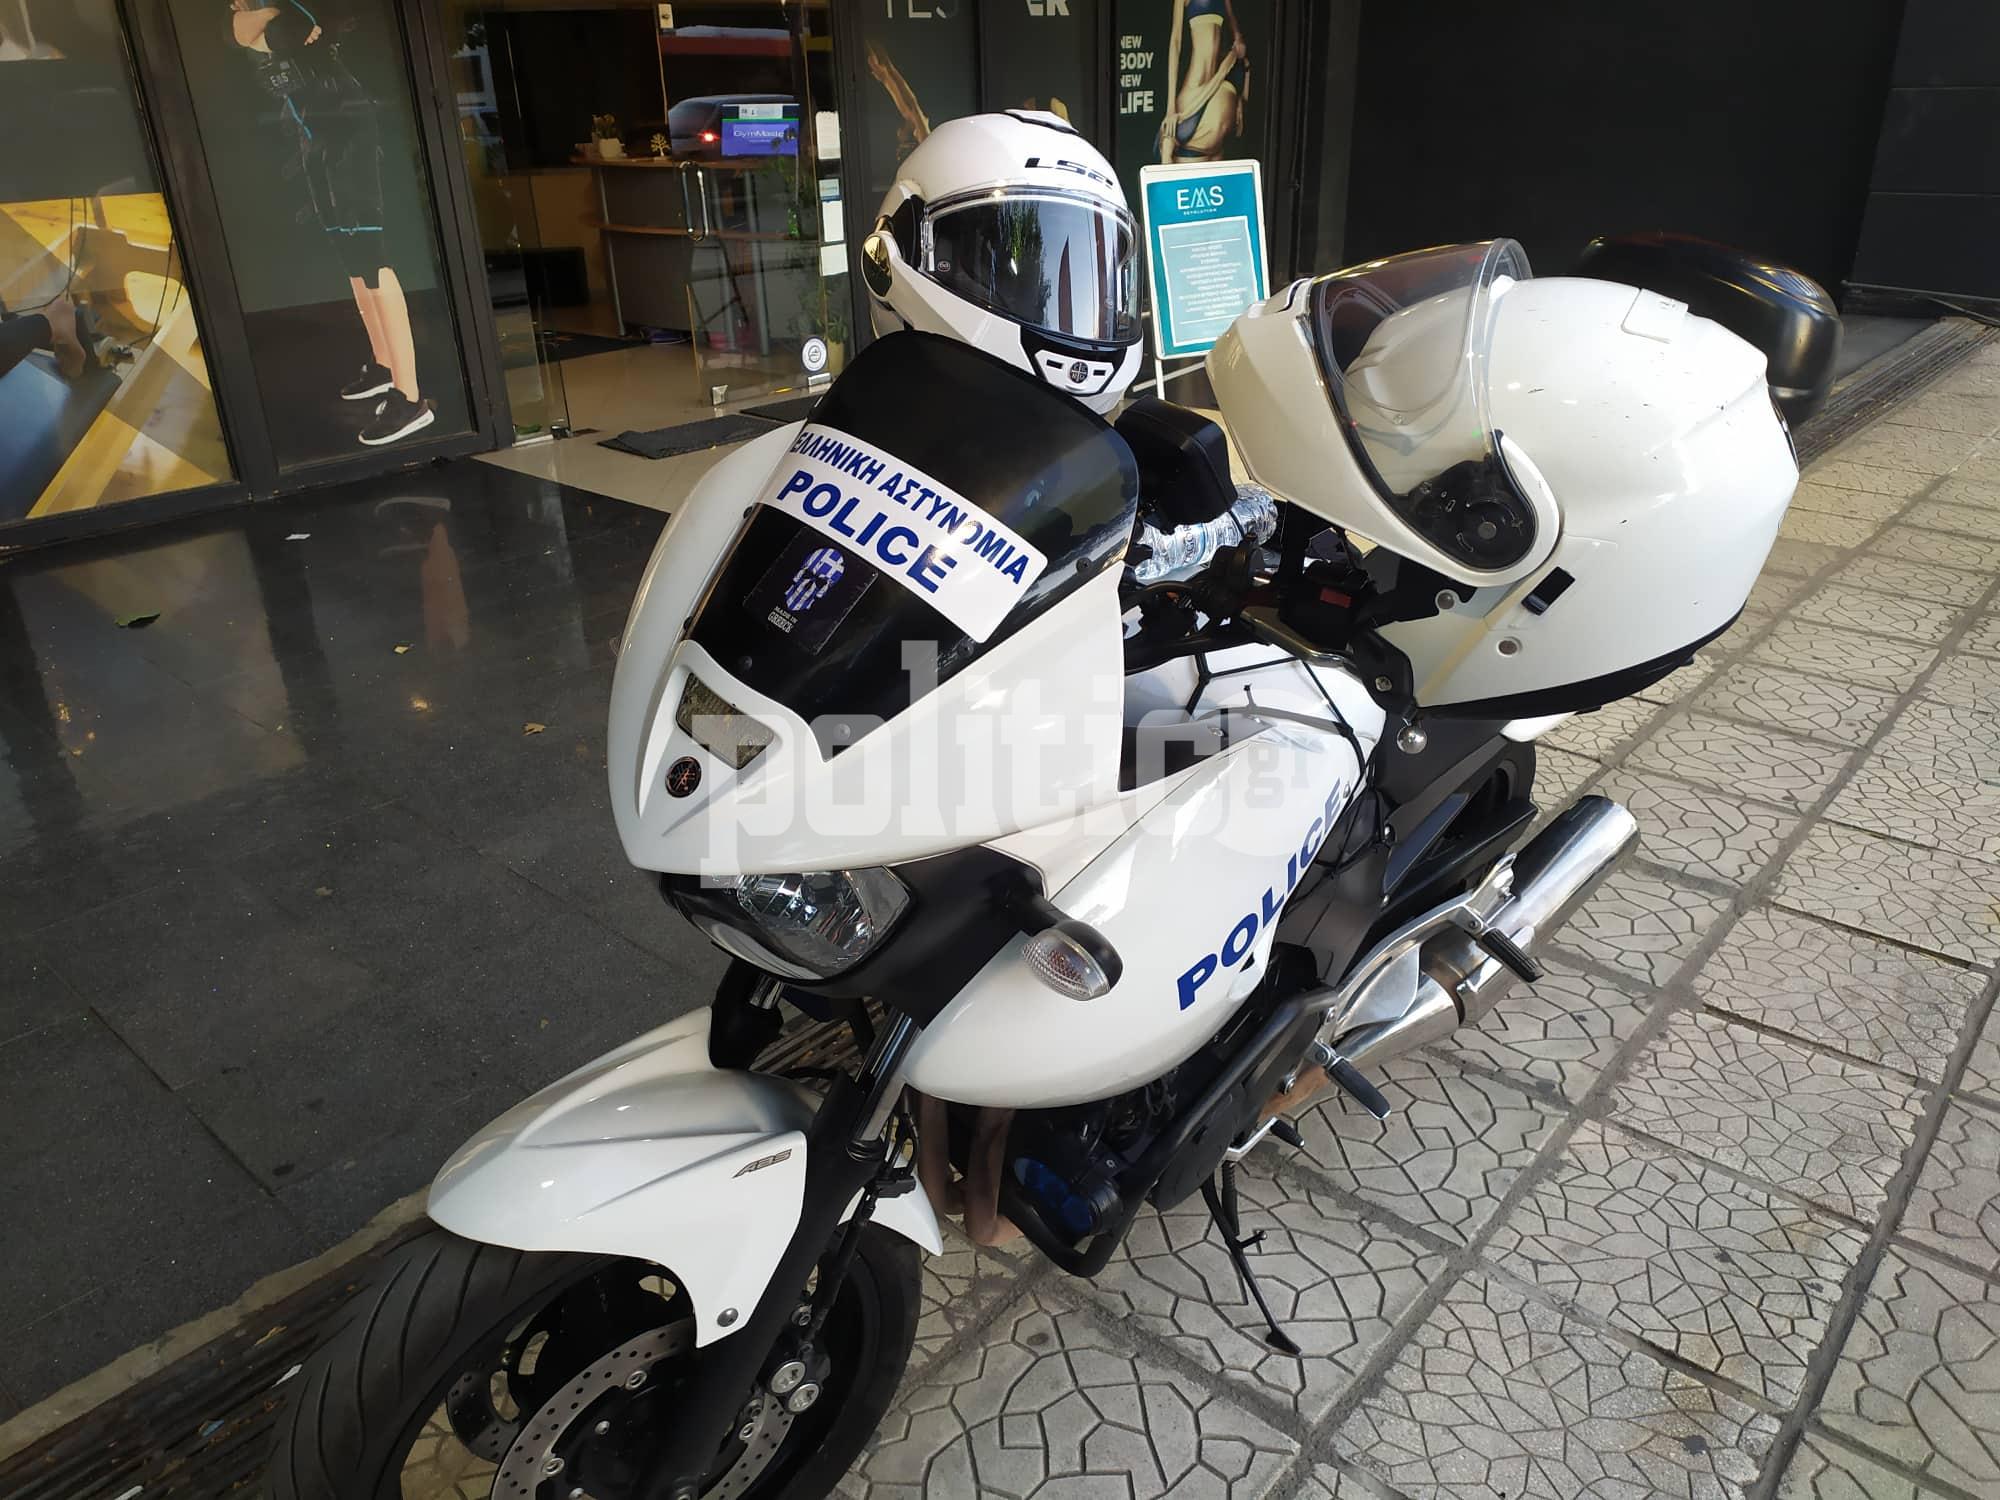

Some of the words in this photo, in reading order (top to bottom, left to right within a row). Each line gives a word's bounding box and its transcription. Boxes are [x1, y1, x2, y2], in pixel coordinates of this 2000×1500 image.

[1120, 90, 1154, 114] LIFE
[1176, 185, 1224, 210] EMS
[777, 470, 957, 594] POLICE
[878, 472, 1030, 584] ΑΣΤΥΝΟΜΙΑ
[1177, 777, 1341, 1011] POLICE
[732, 1149, 792, 1179] ABS
